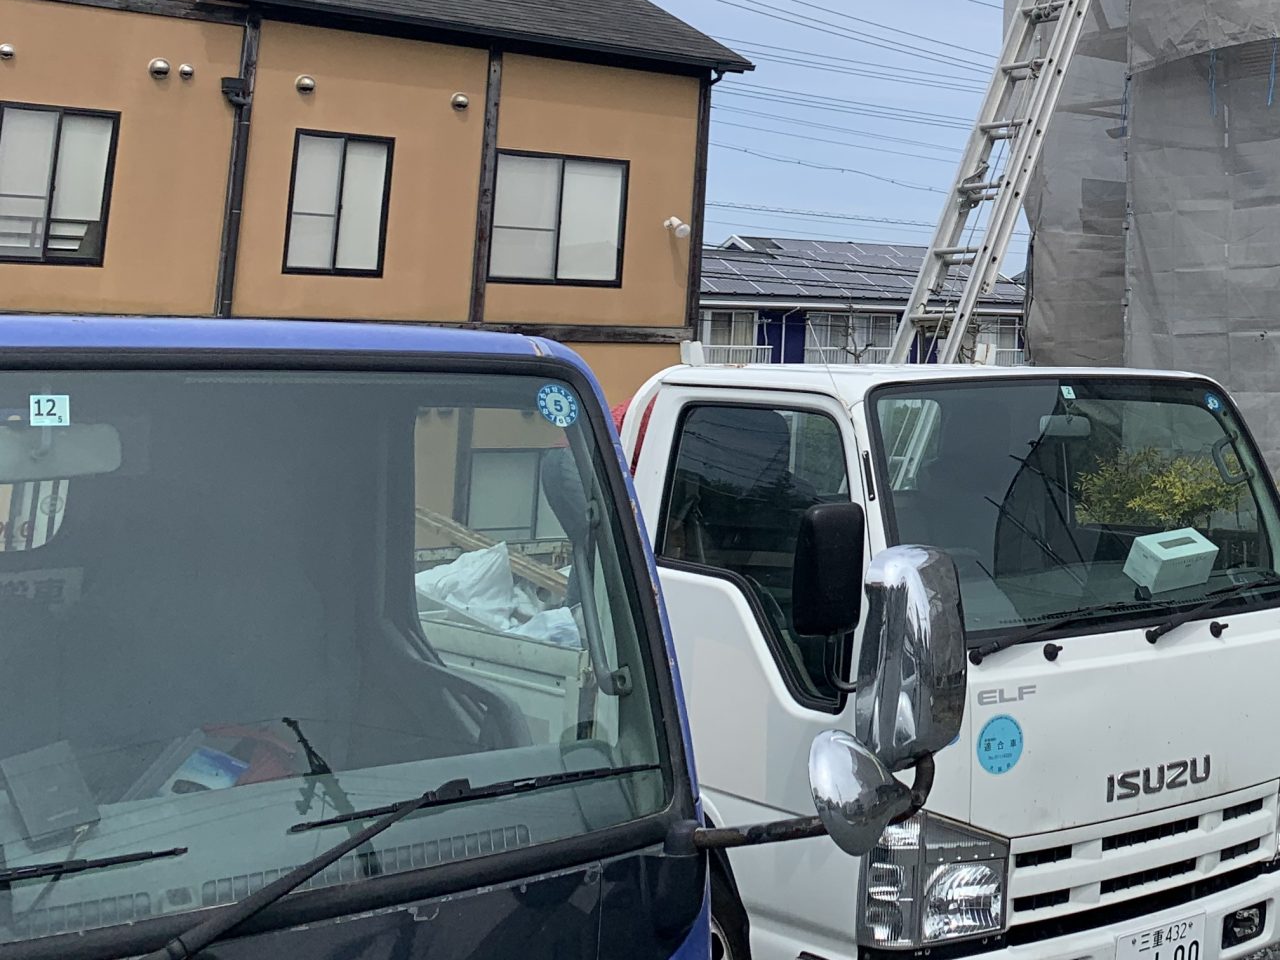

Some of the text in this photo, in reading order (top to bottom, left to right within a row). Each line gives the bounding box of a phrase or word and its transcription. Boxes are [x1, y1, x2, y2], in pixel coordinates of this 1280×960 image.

[34, 398, 57, 417] 12
[553, 399, 563, 413] 5
[57, 415, 63, 423] 5
[977, 684, 1037, 706] ELF
[1105, 753, 1212, 804] ISUZU
